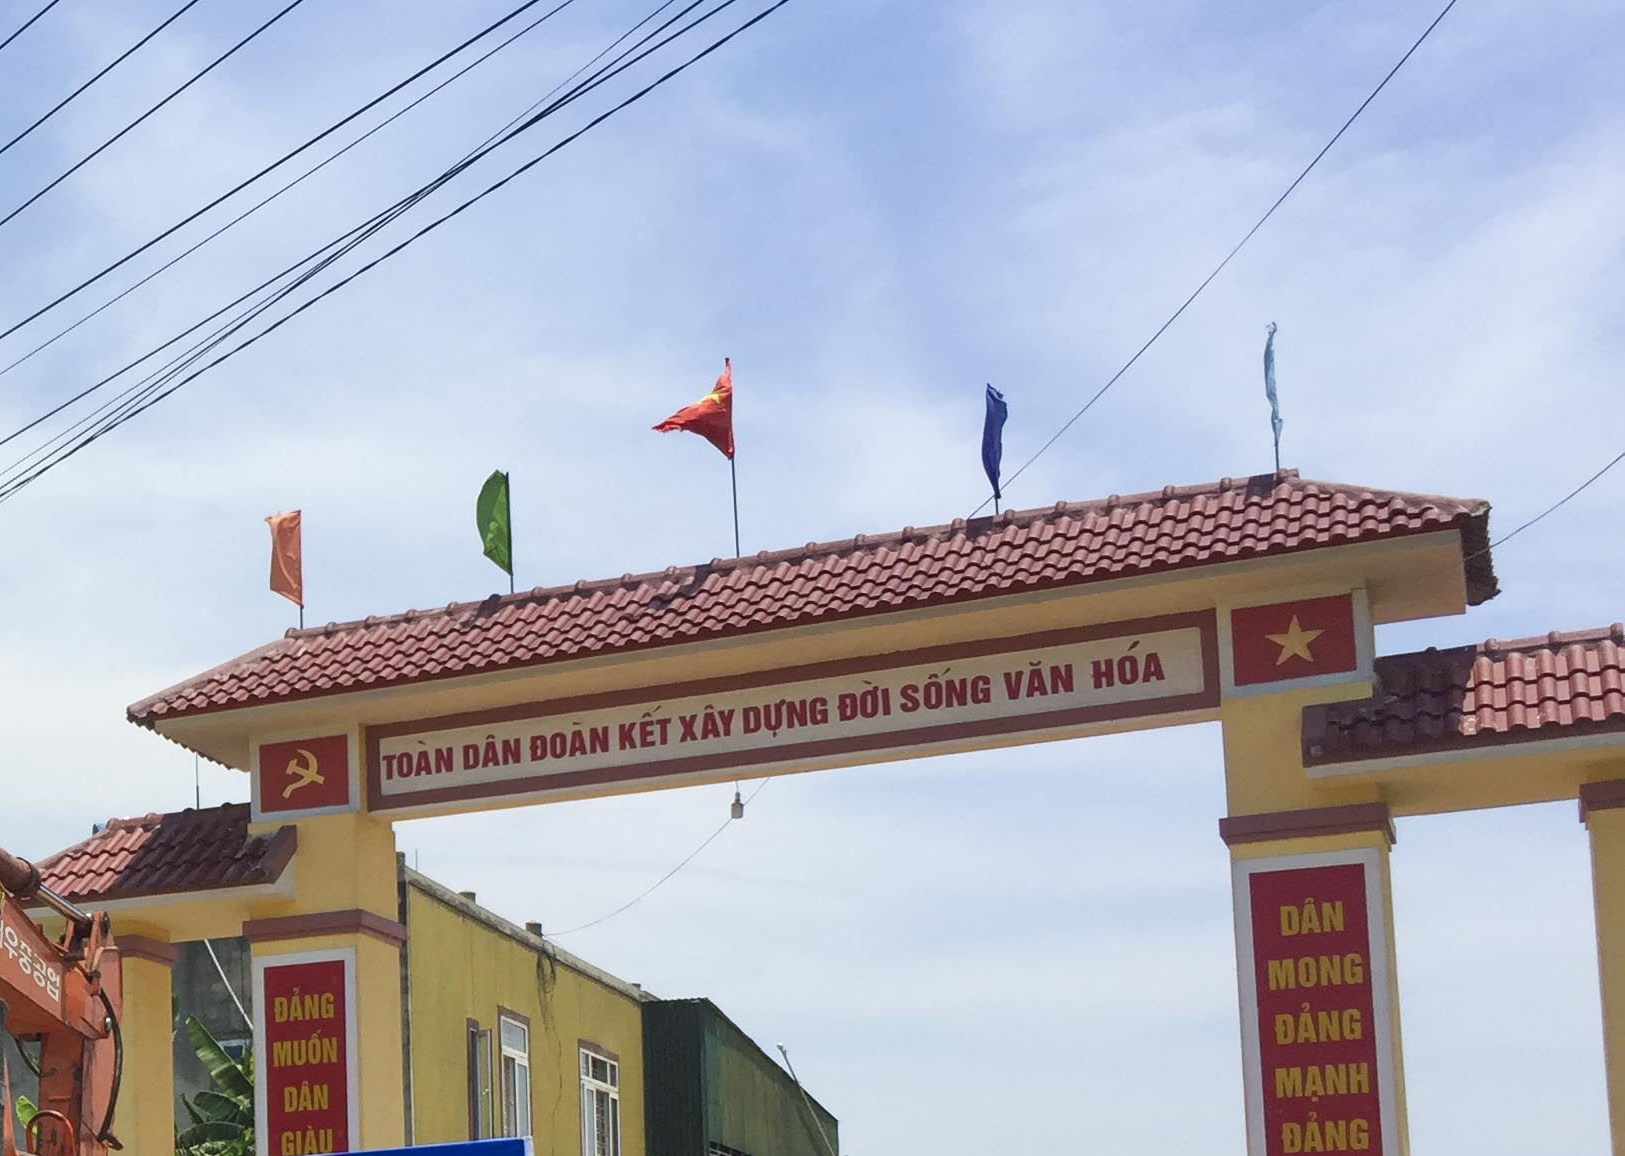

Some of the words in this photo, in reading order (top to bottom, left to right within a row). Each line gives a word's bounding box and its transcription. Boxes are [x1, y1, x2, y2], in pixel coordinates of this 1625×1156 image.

[382, 740, 453, 780] TOÀN
[462, 734, 521, 770] DÂN
[529, 722, 609, 762] ĐOÀN
[618, 705, 671, 751] KẾT
[679, 704, 735, 743] XÂY
[742, 698, 828, 738] DỰNG
[837, 680, 891, 722] ĐỜI
[899, 667, 991, 713] SỐNG
[1003, 660, 1074, 700] VĂN
[1091, 640, 1165, 689] HÓA
[1280, 897, 1344, 936] DÂN
[1268, 954, 1364, 990] MONG
[274, 987, 334, 1023] ĐẢNG
[1274, 1002, 1362, 1045] ĐẢNG
[273, 1030, 338, 1067] MUỐN
[284, 1081, 328, 1112] DÂN
[1274, 1063, 1369, 1102] MẠNH
[280, 1125, 333, 1156] GIÀU
[1281, 1111, 1369, 1153] ĐẢNG
